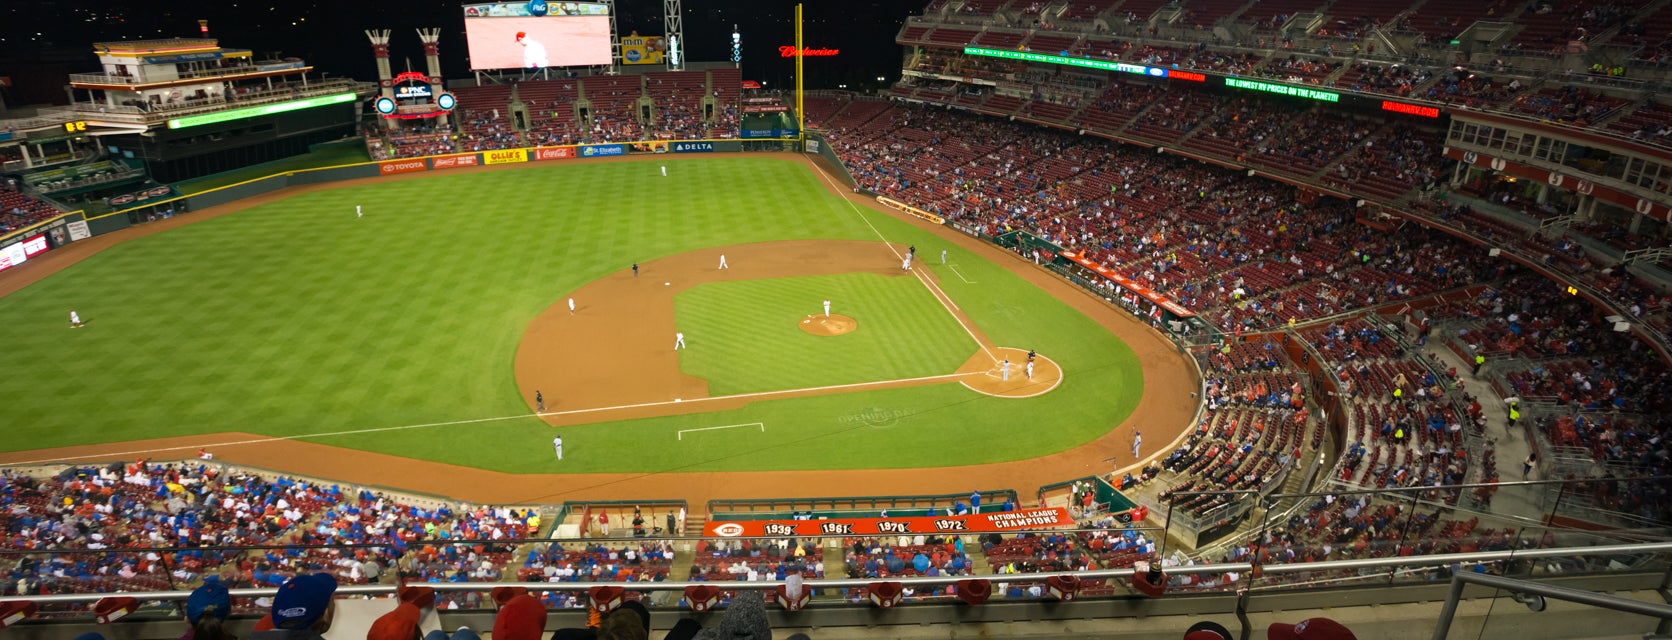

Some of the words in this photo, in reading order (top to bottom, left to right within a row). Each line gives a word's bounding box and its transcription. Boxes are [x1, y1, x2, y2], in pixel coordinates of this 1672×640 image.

[1225, 78, 1235, 86] THE
[1236, 79, 1258, 90] LOWEST
[1258, 83, 1267, 91] RV
[1267, 84, 1288, 94] PRICES
[1288, 87, 1297, 96] ON
[1297, 88, 1309, 98] THE
[1309, 90, 1339, 102] PLANET!!!
[490, 151, 520, 160] OLLIE'S
[543, 148, 567, 158] Coca-Cola
[395, 161, 424, 171] TOYOTA
[838, 411, 892, 423] OPENING
[987, 513, 1026, 521] NATIONAL
[1027, 509, 1059, 518] LEAGUE
[878, 522, 906, 532] 1970
[936, 520, 963, 530] 1972
[995, 516, 1058, 528] CHAMPIONS
[766, 524, 791, 535] 1939
[822, 523, 848, 534] 1961
